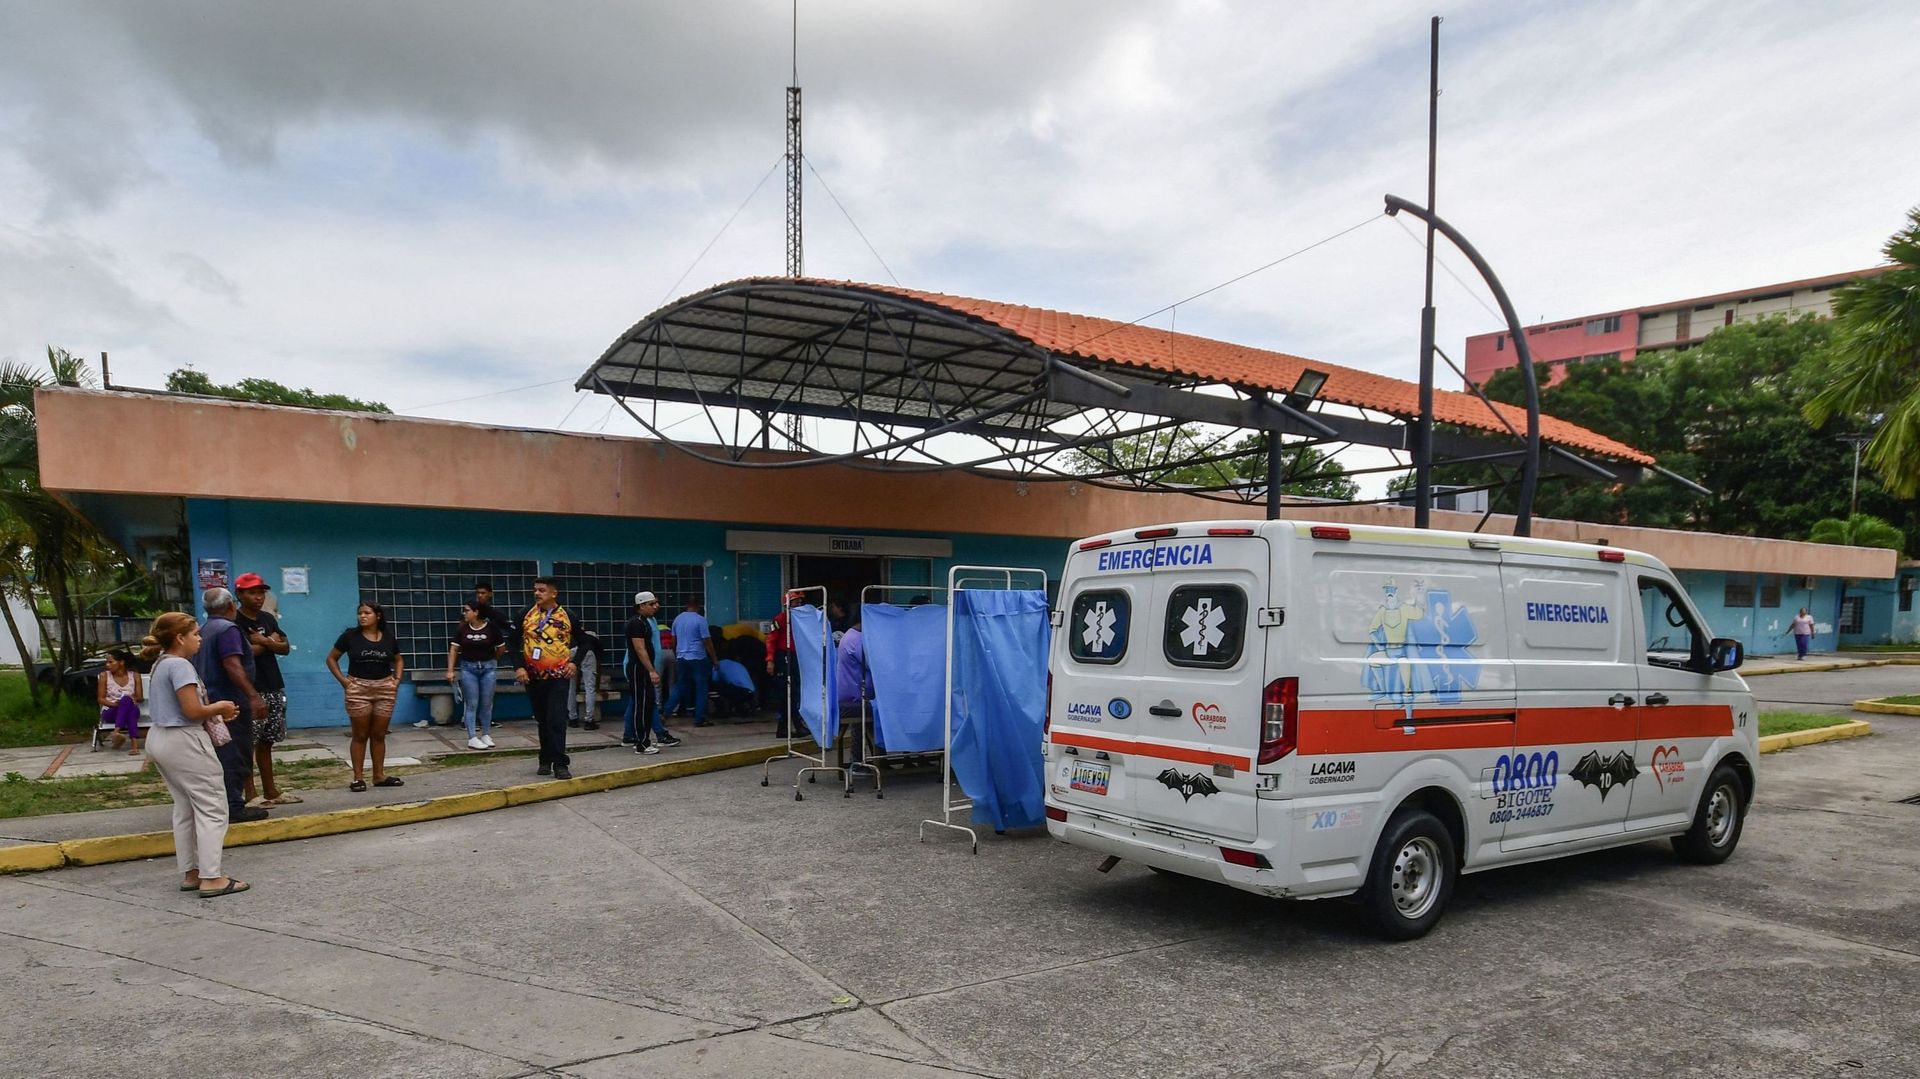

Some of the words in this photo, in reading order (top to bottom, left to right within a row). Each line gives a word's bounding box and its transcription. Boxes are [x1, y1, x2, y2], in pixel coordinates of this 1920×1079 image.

[832, 539, 863, 551] ENTRADA
[1098, 544, 1212, 571] EMERGENCIA
[1527, 602, 1609, 624] EMERGENCIA
[1068, 702, 1102, 716] LACAVA
[1067, 714, 1102, 724] GOBERNADOR
[1200, 713, 1227, 723] CARABOBO
[1738, 712, 1748, 727] 11
[1310, 760, 1356, 776] LACAVA
[1492, 750, 1559, 797] 0800
[1309, 774, 1355, 785] GOBERNADOR
[1600, 772, 1611, 789] 10
[1181, 783, 1193, 795] 10
[1497, 788, 1553, 809] BIGOTE
[1489, 803, 1554, 824] 0800-2446837
